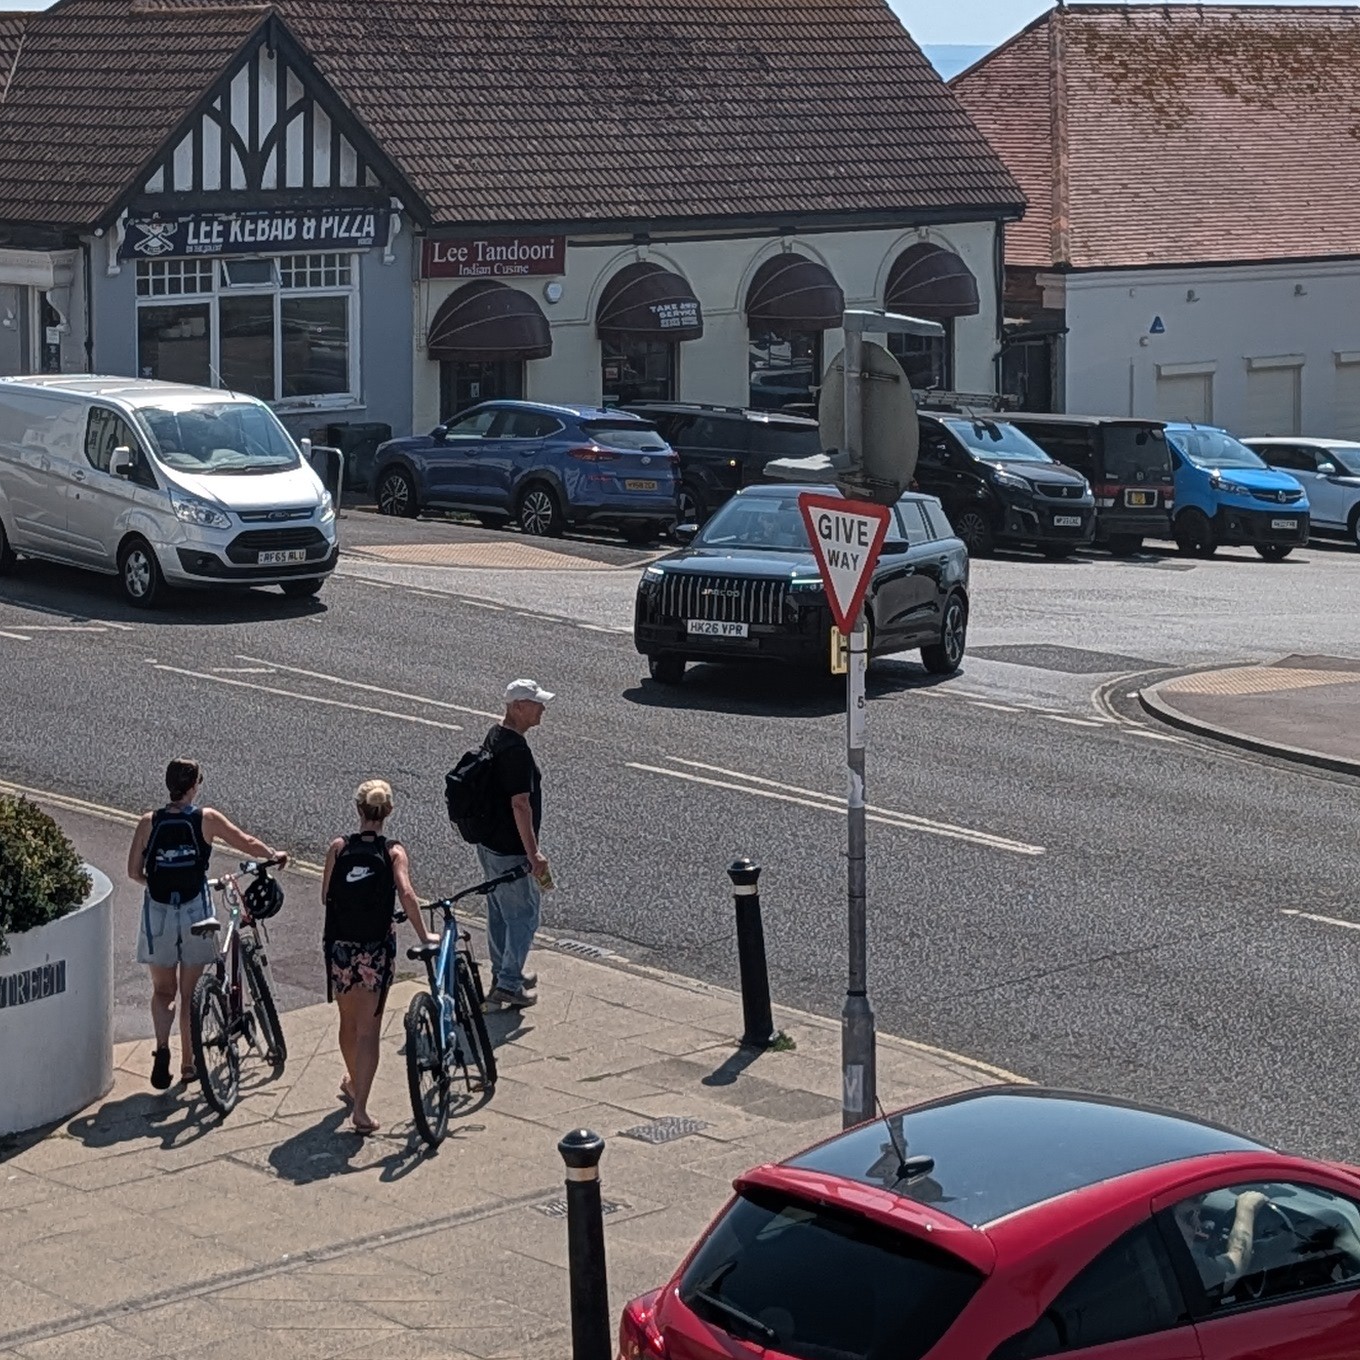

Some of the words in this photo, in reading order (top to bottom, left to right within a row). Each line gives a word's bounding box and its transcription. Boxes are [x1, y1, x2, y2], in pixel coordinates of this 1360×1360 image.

[187, 218, 224, 244] LEE
[229, 216, 297, 243] KEBAB
[302, 216, 315, 240] &
[320, 214, 376, 239] PIZZA
[433, 242, 468, 262] Lee
[473, 239, 555, 261] Tandoori
[459, 263, 491, 275] Indian
[818, 513, 869, 547] GIVE
[827, 548, 859, 571] WAY
[857, 695, 865, 709] 5
